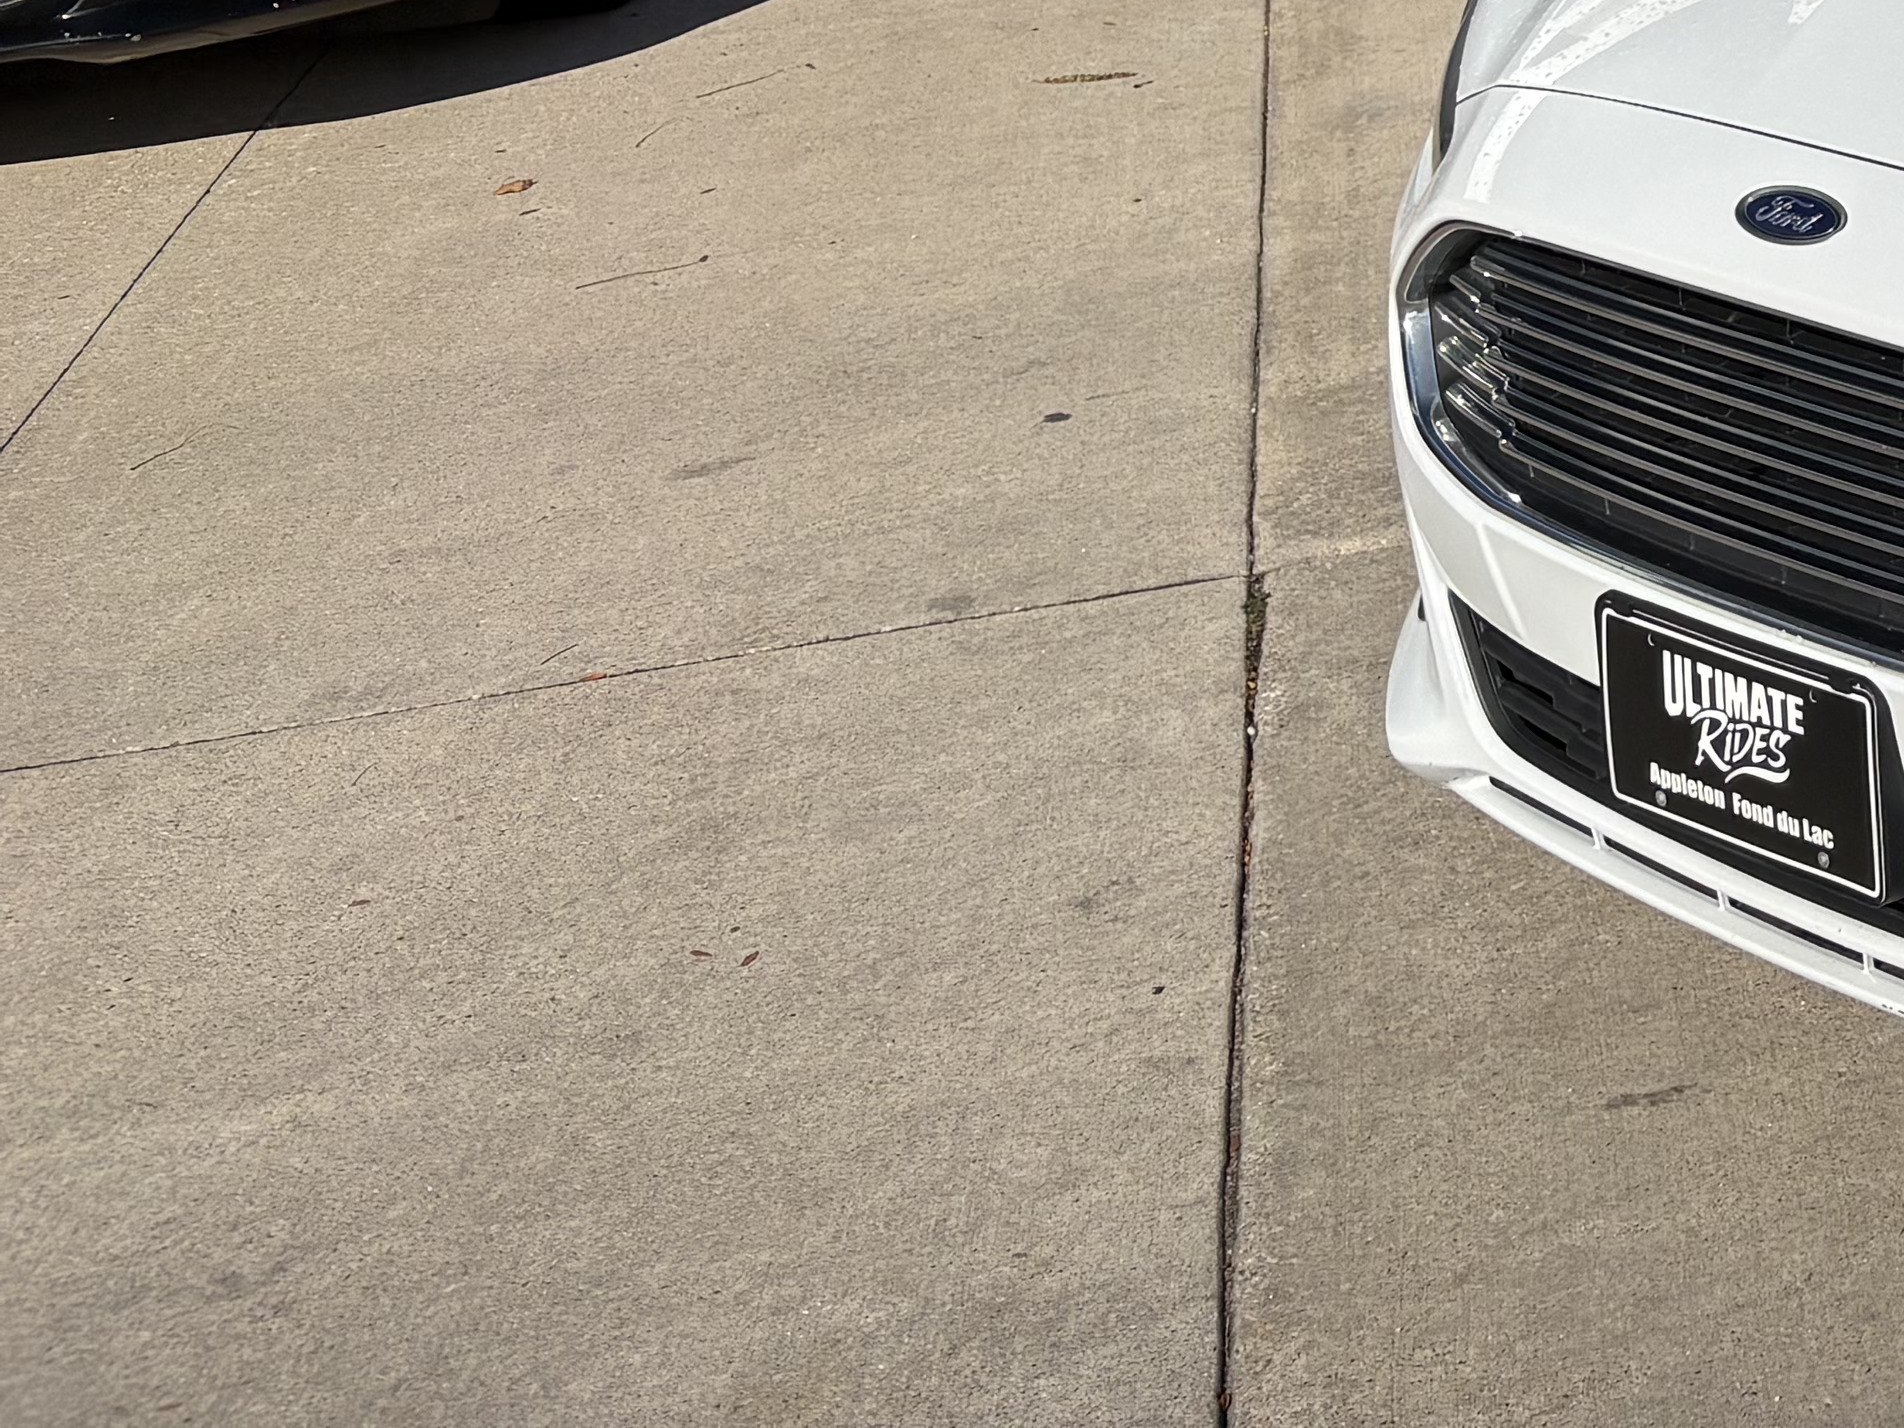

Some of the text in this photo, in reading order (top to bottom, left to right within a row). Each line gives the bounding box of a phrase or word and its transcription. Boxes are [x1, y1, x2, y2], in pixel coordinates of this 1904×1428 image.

[1756, 195, 1823, 232] Ford
[1662, 649, 1805, 735] ULTIMATE
[1650, 761, 1834, 850] Appleton Fond du Lac
